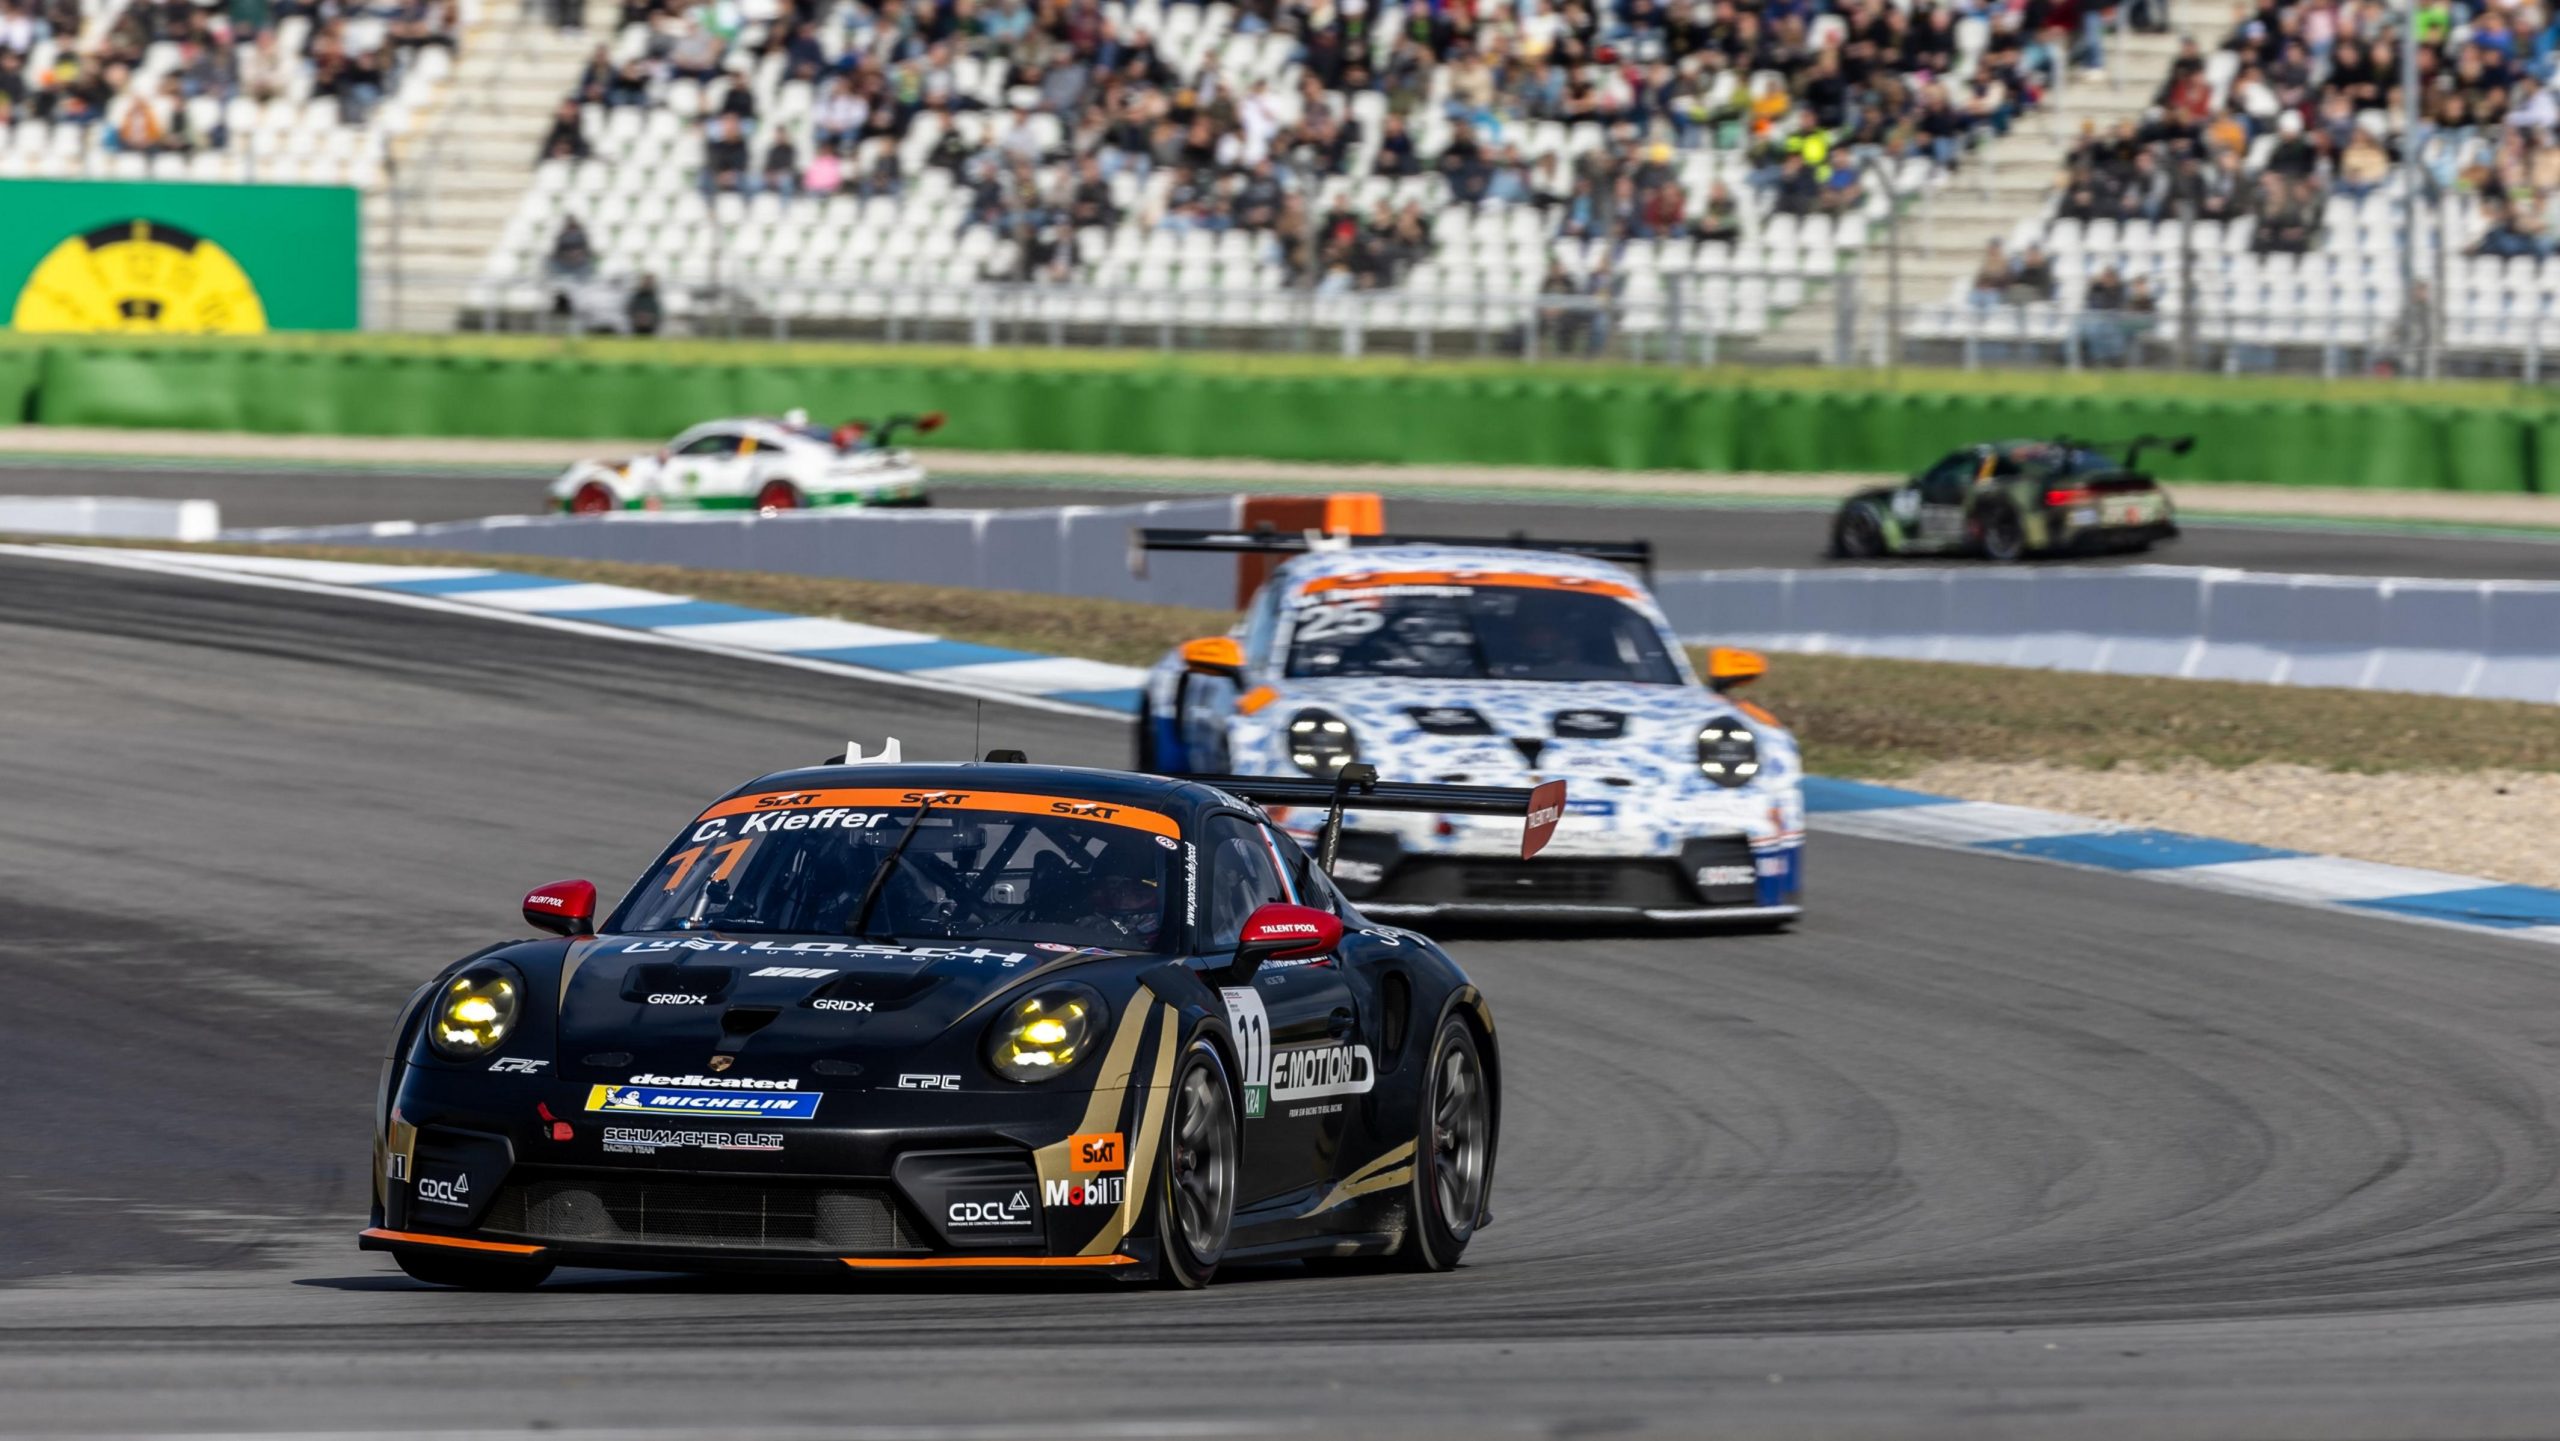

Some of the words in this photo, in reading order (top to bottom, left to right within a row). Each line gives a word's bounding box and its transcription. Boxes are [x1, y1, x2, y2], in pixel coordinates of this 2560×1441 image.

[1296, 601, 1384, 641] 25
[755, 793, 821, 808] SIXT
[1051, 802, 1119, 819] SIXT
[692, 818, 728, 842] C.
[739, 808, 888, 835] Kieffer
[662, 838, 753, 892] 11
[528, 896, 549, 904] TALENT
[547, 897, 564, 907] POOL
[1260, 924, 1294, 934] TALENT
[1294, 924, 1319, 933] POOL
[1238, 1014, 1262, 1082] 11
[629, 1073, 799, 1090] dedicated
[650, 1095, 799, 1110] MICHELIN
[603, 1127, 732, 1146] SCHUMACHER
[735, 1133, 784, 1148] CLRT
[603, 1144, 632, 1153] RACING
[1082, 1139, 1115, 1163] SIXT
[419, 1178, 458, 1201] CDCL
[1046, 1178, 1107, 1206] Mobil
[1111, 1178, 1122, 1202] 1
[949, 1201, 1014, 1221] CDCL
